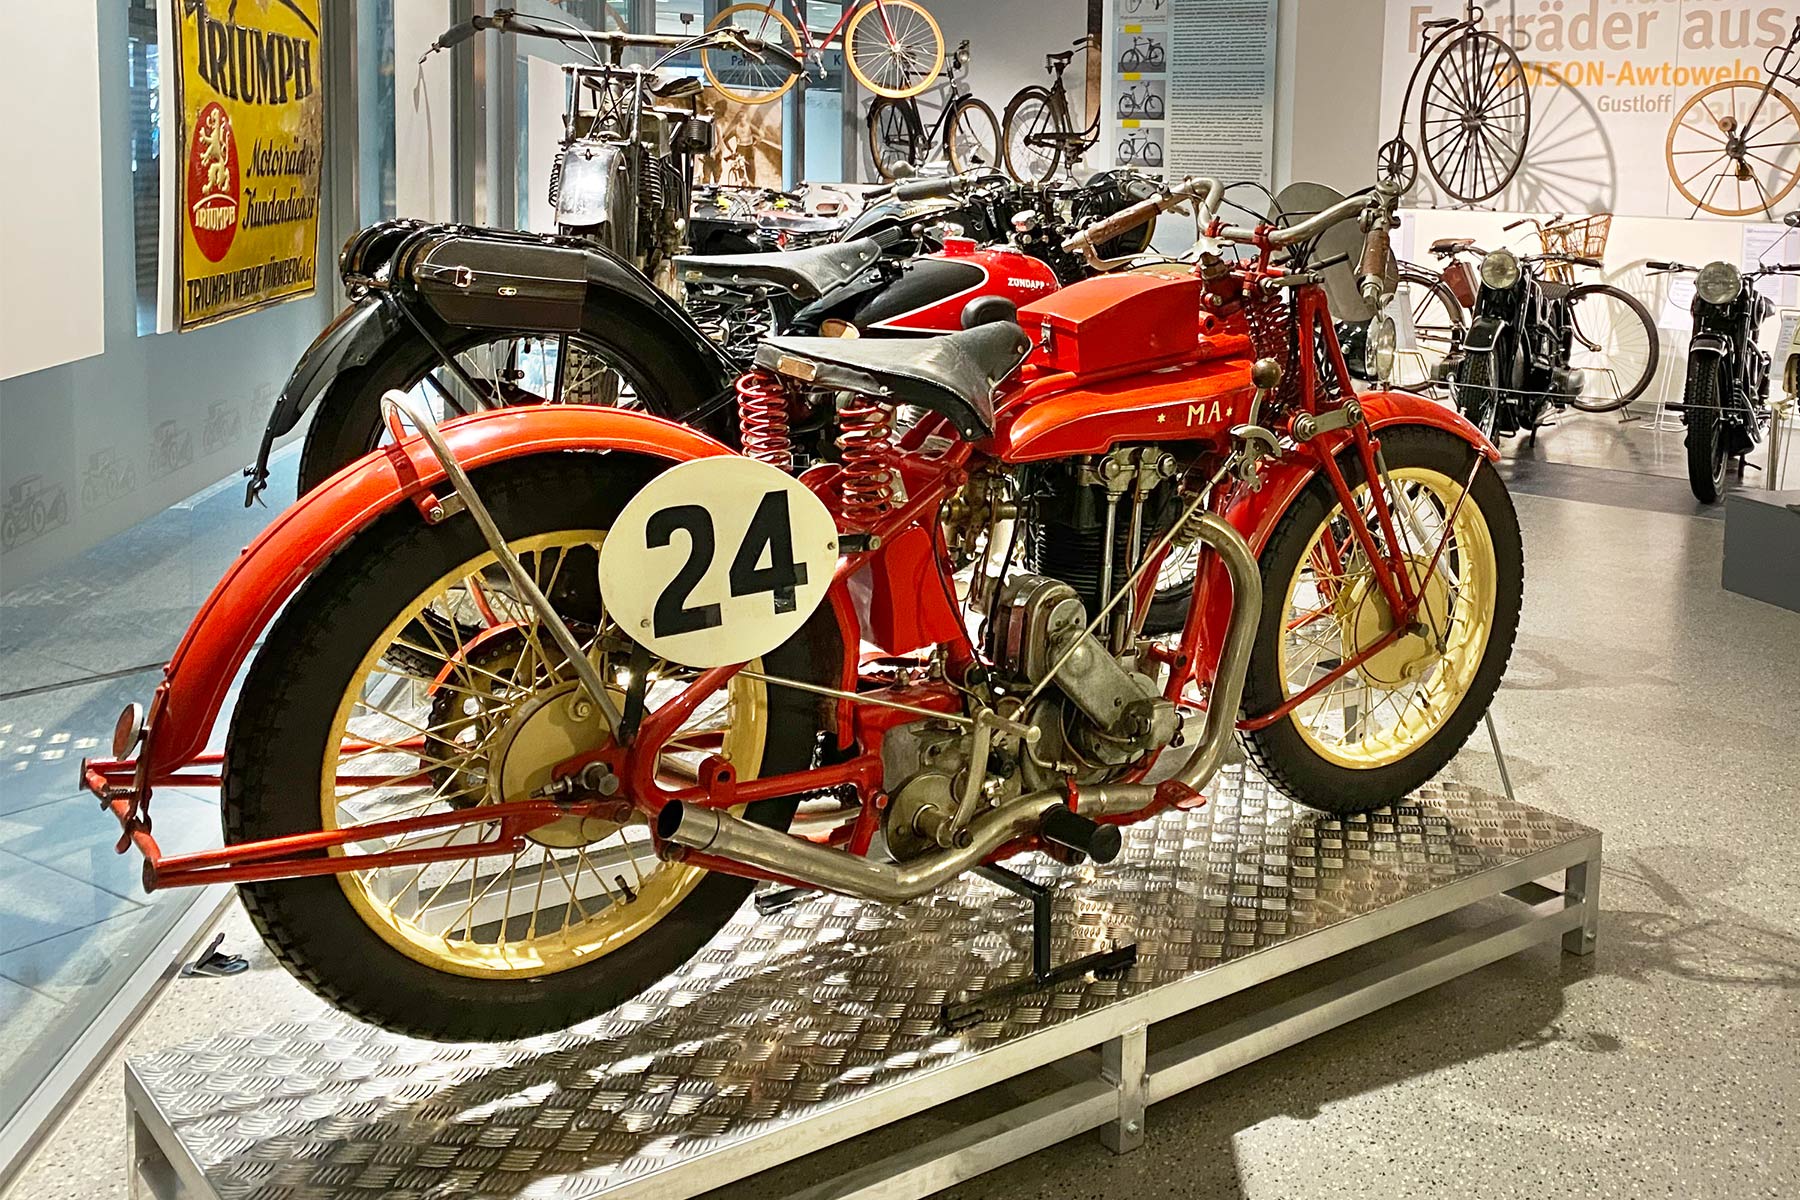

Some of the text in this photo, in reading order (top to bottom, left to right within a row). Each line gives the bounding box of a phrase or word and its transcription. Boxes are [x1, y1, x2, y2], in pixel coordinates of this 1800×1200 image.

[1683, 7, 1787, 50] aus
[188, 0, 314, 105] TRIUMPH
[1597, 94, 1673, 113] Gustloff
[186, 272, 231, 314] TRIUMPH
[645, 489, 808, 639] 24
